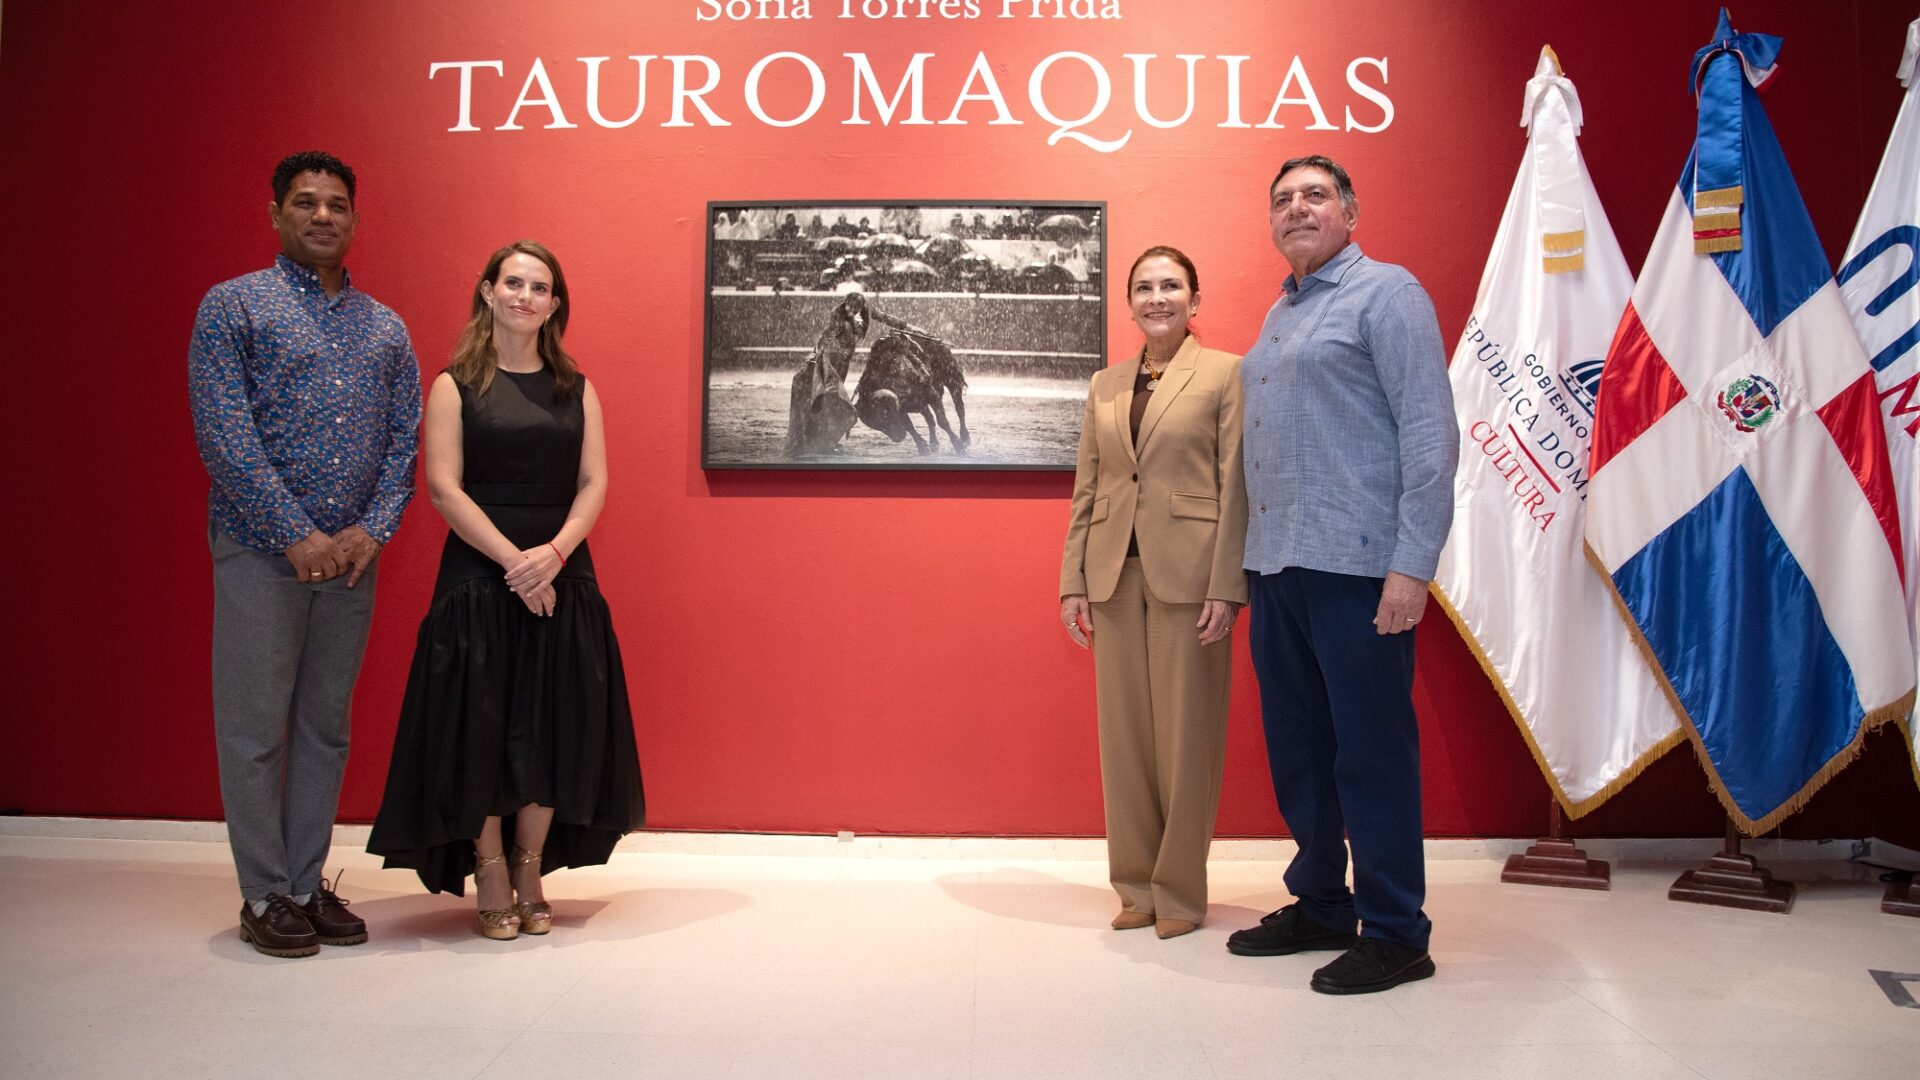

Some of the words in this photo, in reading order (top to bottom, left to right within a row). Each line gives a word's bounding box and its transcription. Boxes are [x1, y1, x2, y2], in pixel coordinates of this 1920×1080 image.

[428, 50, 1396, 154] TAUROMAQUIAS
[1464, 316, 1541, 433] EPÚBLICA
[1524, 353, 1588, 439] GOBIERNO
[1470, 420, 1557, 533] CULTURA
